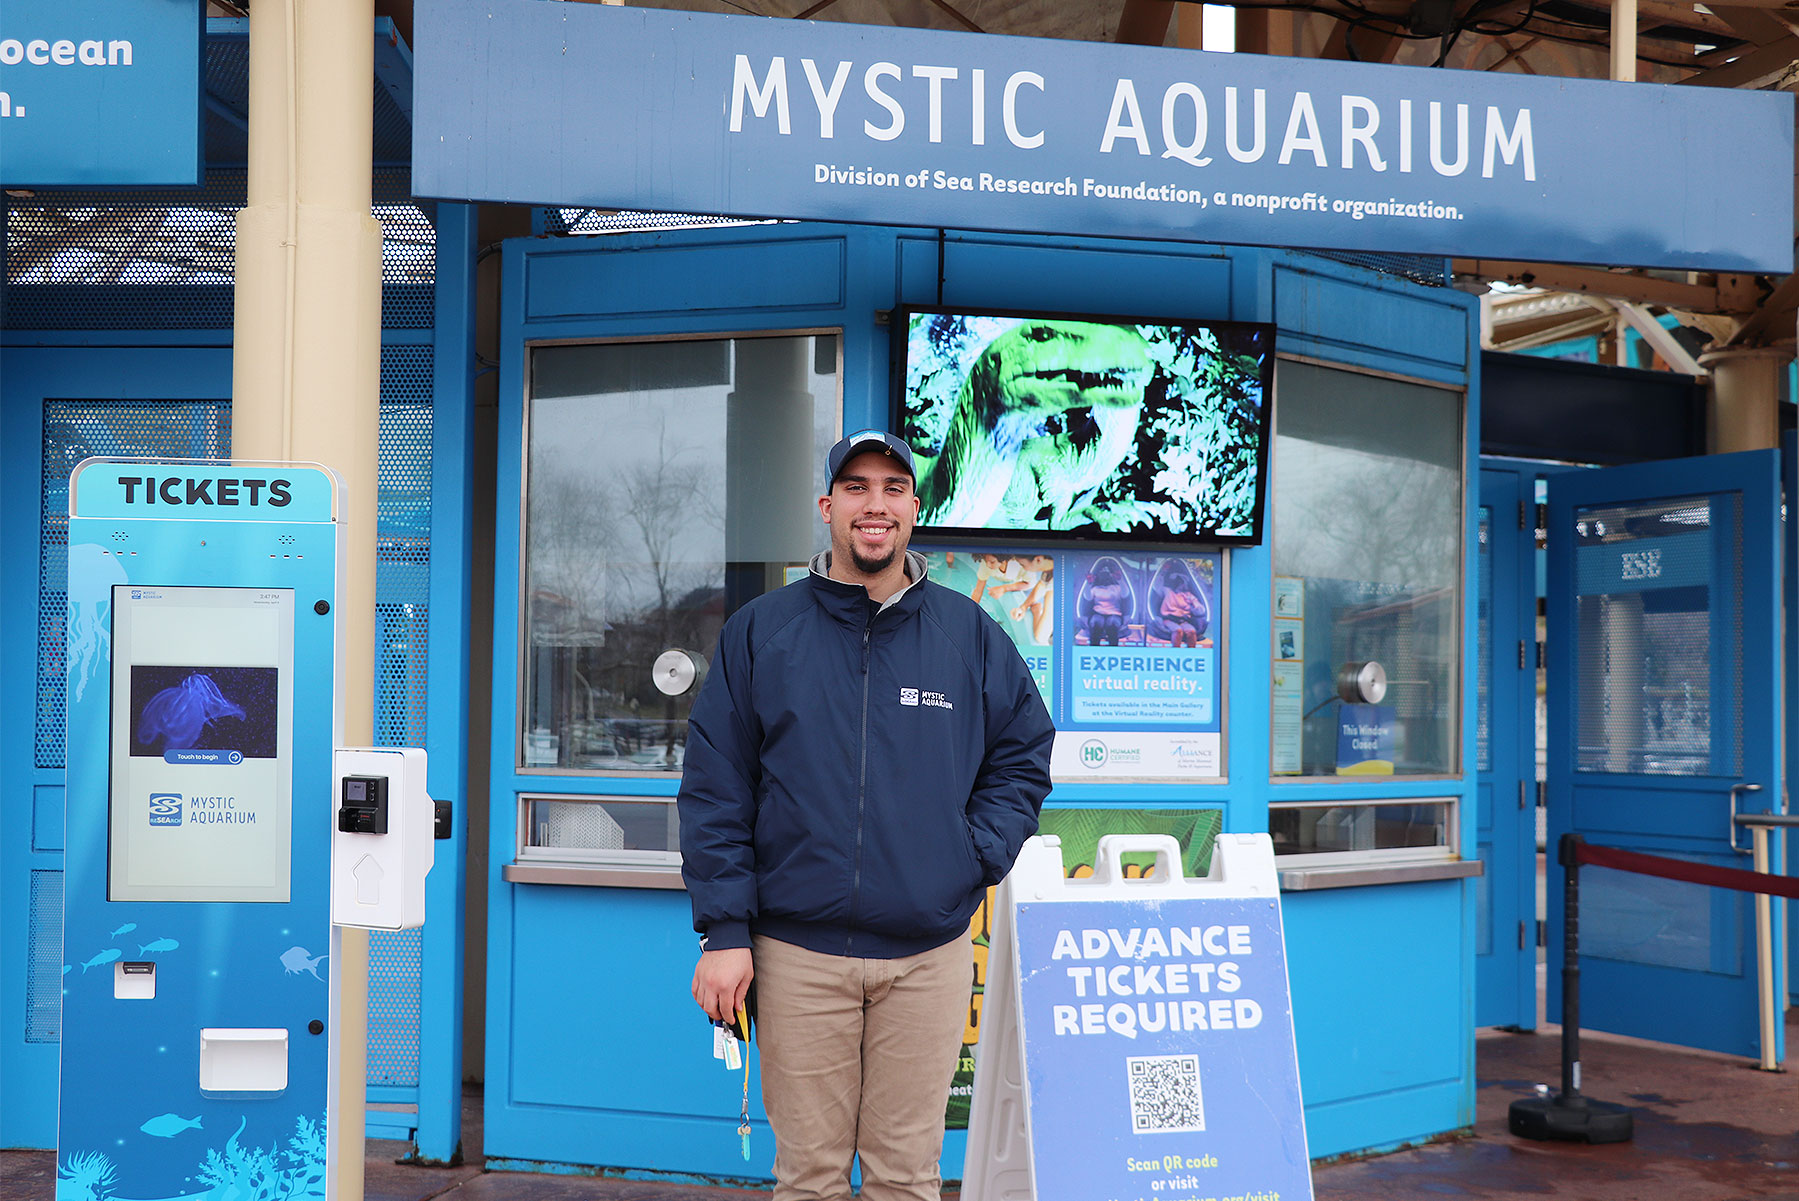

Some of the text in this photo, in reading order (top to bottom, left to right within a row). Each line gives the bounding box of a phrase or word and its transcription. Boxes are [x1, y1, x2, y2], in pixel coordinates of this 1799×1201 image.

[0, 38, 133, 66] ocean
[729, 53, 1537, 182] MYSTIC AQUARIUM
[815, 163, 1464, 221] Division of Sea Research Foundation, a nonprofit organization.
[118, 476, 293, 508] TICKETS
[1080, 656, 1206, 673] EXPERIENCE
[1082, 674, 1203, 695] virtual reality.
[921, 690, 945, 700] MYSTIC
[921, 697, 954, 710] AQUARIUM
[1180, 702, 1204, 710] Gallery
[1342, 724, 1389, 736] This Window
[1352, 738, 1378, 750] Closed
[190, 796, 235, 809] MYSTIC
[190, 811, 256, 824] AQUARIUM
[1051, 925, 1252, 961] ADVANCE
[1066, 961, 1242, 997] TICKETS
[1053, 998, 1263, 1039] REQUIRED
[1127, 1153, 1218, 1173] Scan QR code
[1151, 1174, 1199, 1191] or visit
